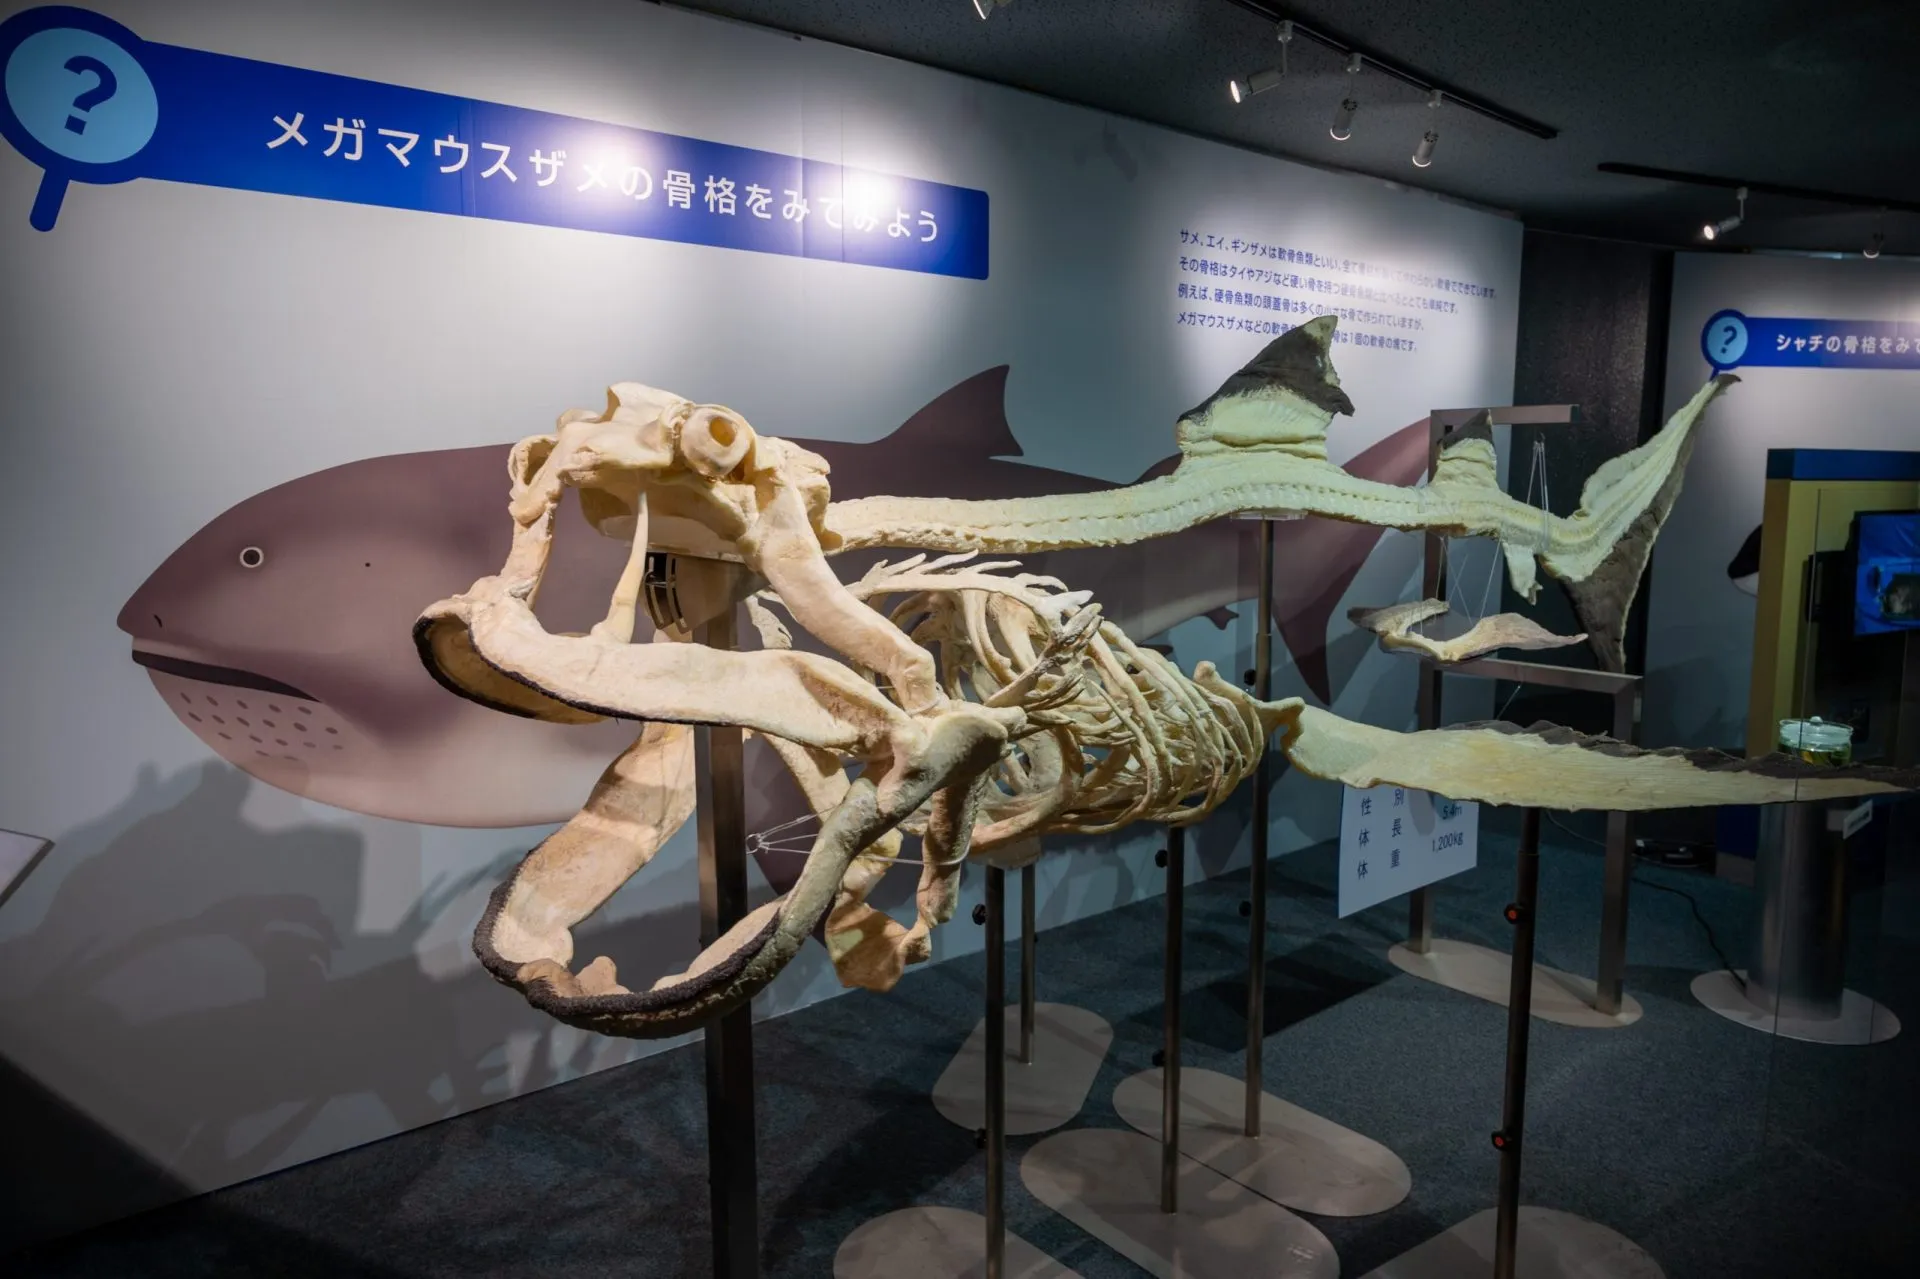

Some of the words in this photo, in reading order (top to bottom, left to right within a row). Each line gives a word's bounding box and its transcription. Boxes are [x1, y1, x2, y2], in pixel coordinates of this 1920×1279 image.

[265, 110, 939, 243] メガマウスザメの骨格をみてみよう
